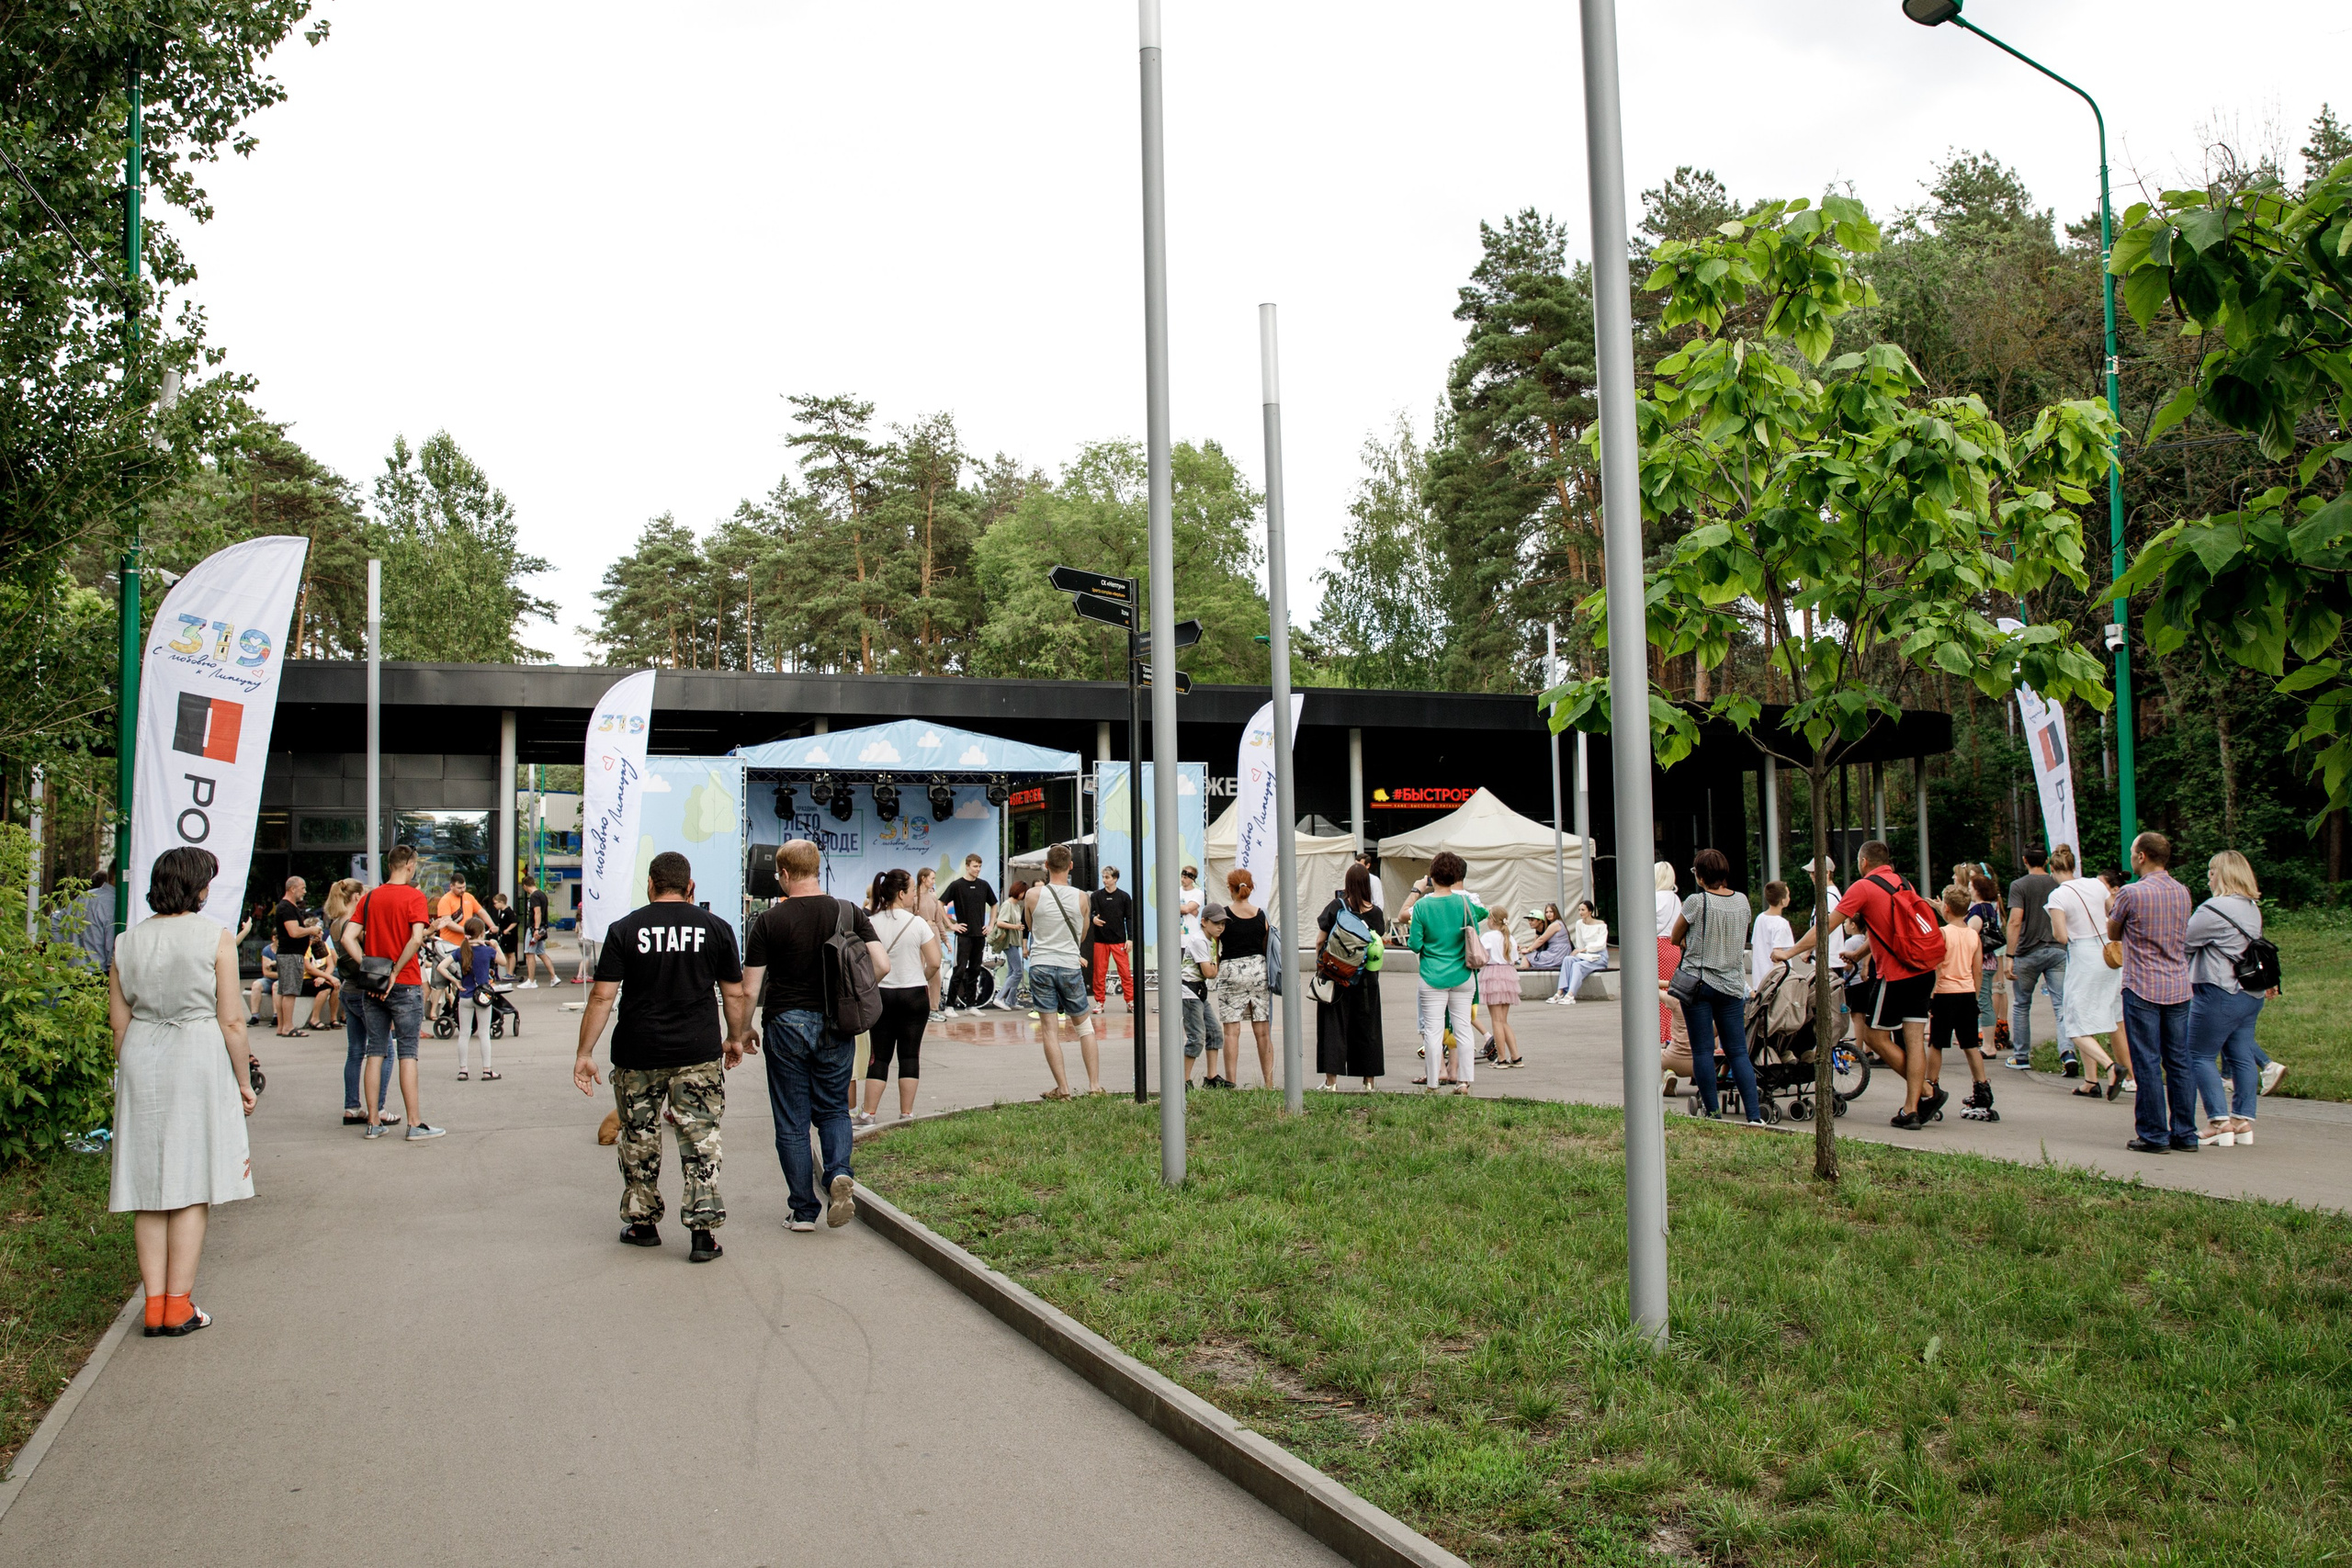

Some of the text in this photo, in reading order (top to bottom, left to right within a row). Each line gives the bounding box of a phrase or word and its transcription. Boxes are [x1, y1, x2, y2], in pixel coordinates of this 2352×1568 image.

[168, 613, 272, 668] 319
[598, 714, 645, 735] 319
[1250, 729, 1274, 750] 31
[784, 813, 820, 831] ЛЕТО
[879, 815, 930, 840] 319
[637, 926, 706, 953] STAFF
